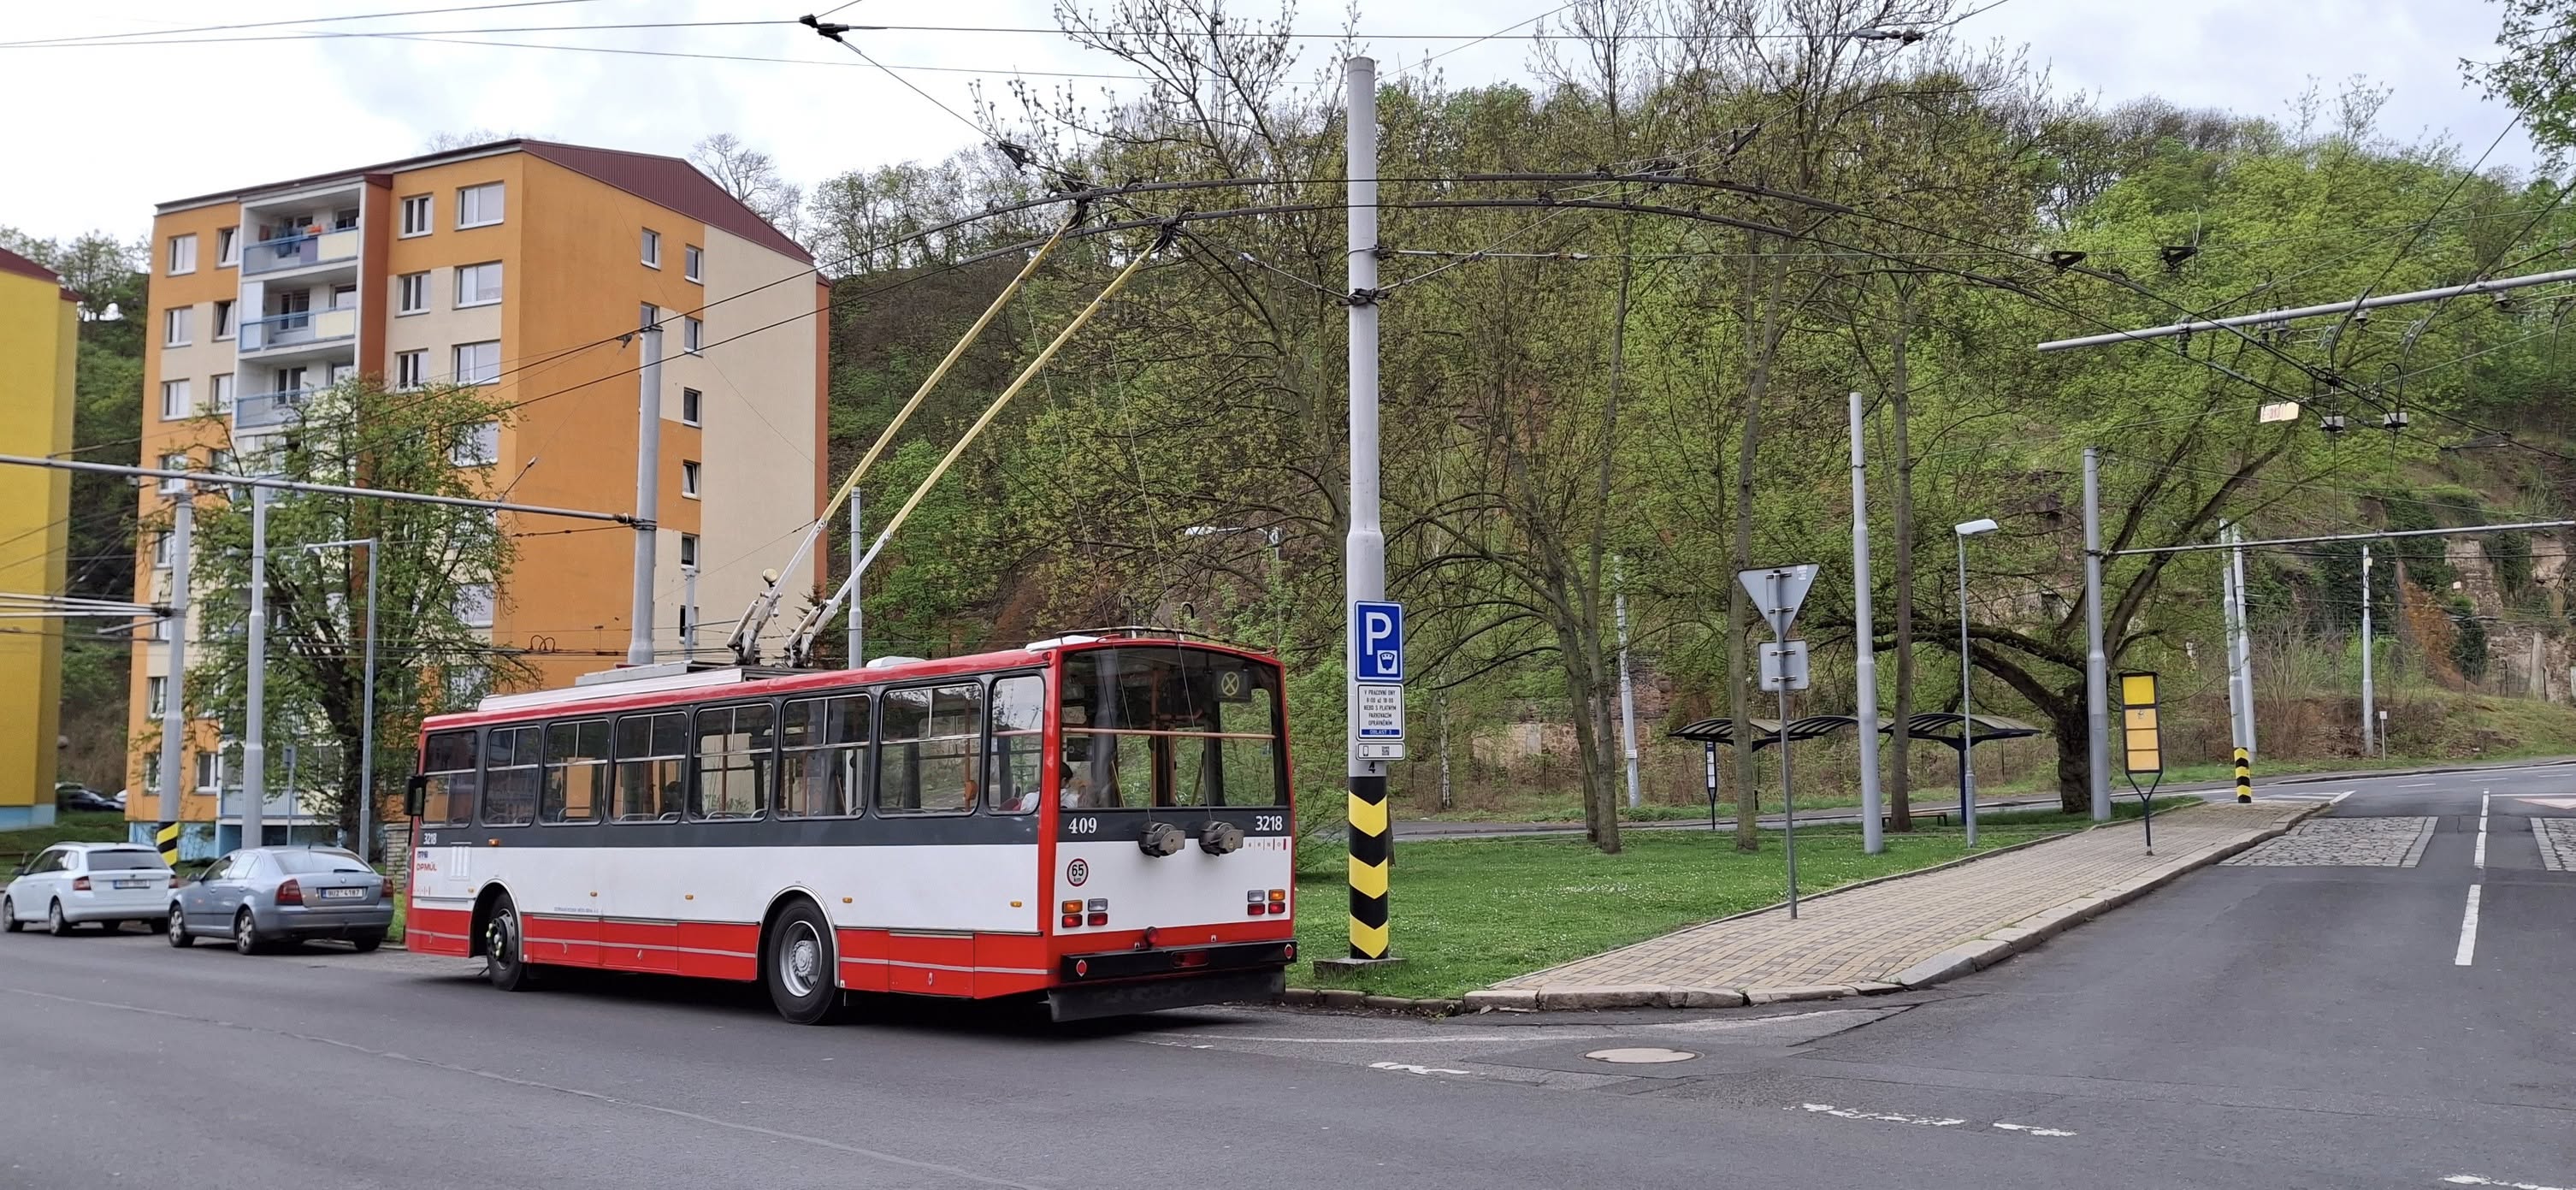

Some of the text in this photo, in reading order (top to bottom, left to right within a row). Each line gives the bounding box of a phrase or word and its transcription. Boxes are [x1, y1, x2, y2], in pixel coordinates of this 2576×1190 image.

[1366, 612, 1392, 656] P
[1068, 817, 1098, 834] 409
[1255, 815, 1283, 832] 3218
[423, 832, 437, 845] 3218
[1072, 864, 1084, 877] 65
